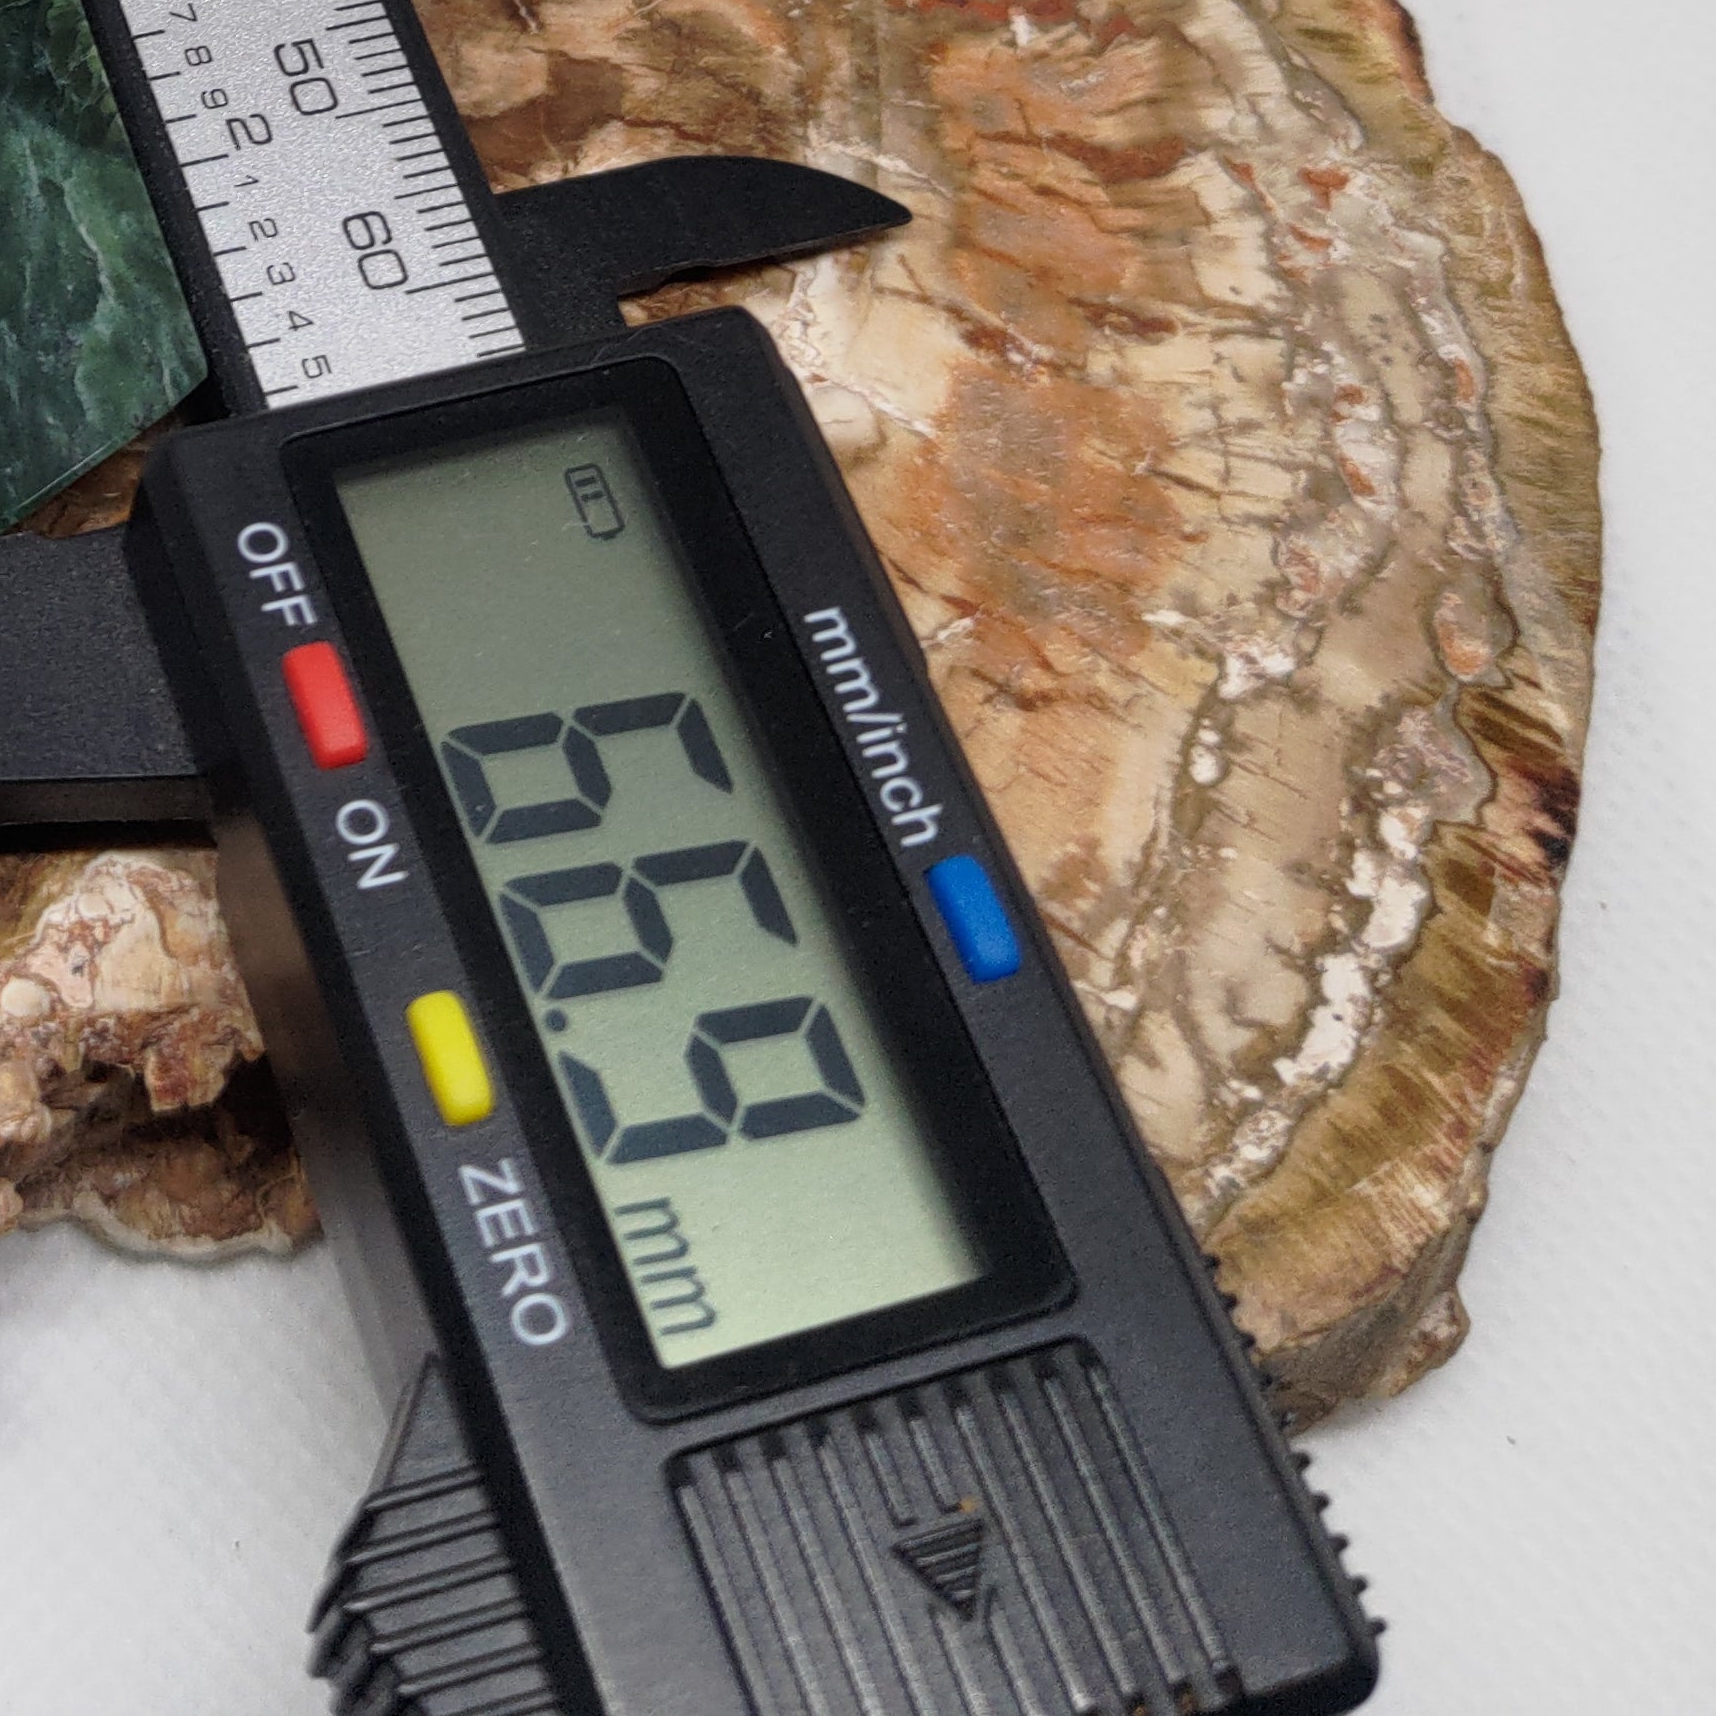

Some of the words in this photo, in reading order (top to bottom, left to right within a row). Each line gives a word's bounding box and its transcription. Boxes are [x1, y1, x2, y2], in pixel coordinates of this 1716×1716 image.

[169, 3, 197, 24] 7
[184, 46, 212, 66] 8
[201, 89, 228, 110] 9
[225, 113, 273, 150] 2
[274, 38, 338, 116] 50
[342, 211, 408, 290] 60
[234, 174, 258, 187] 1
[248, 218, 278, 242] 2
[267, 262, 295, 286] 3
[288, 311, 314, 332] 4
[301, 354, 332, 379] 5
[236, 522, 318, 628] OFF
[804, 606, 943, 846] mm/inch
[335, 800, 409, 889] ON
[440, 691, 866, 1166] 66.9
[457, 1159, 572, 1346] ZERO
[612, 1196, 717, 1336] mm
